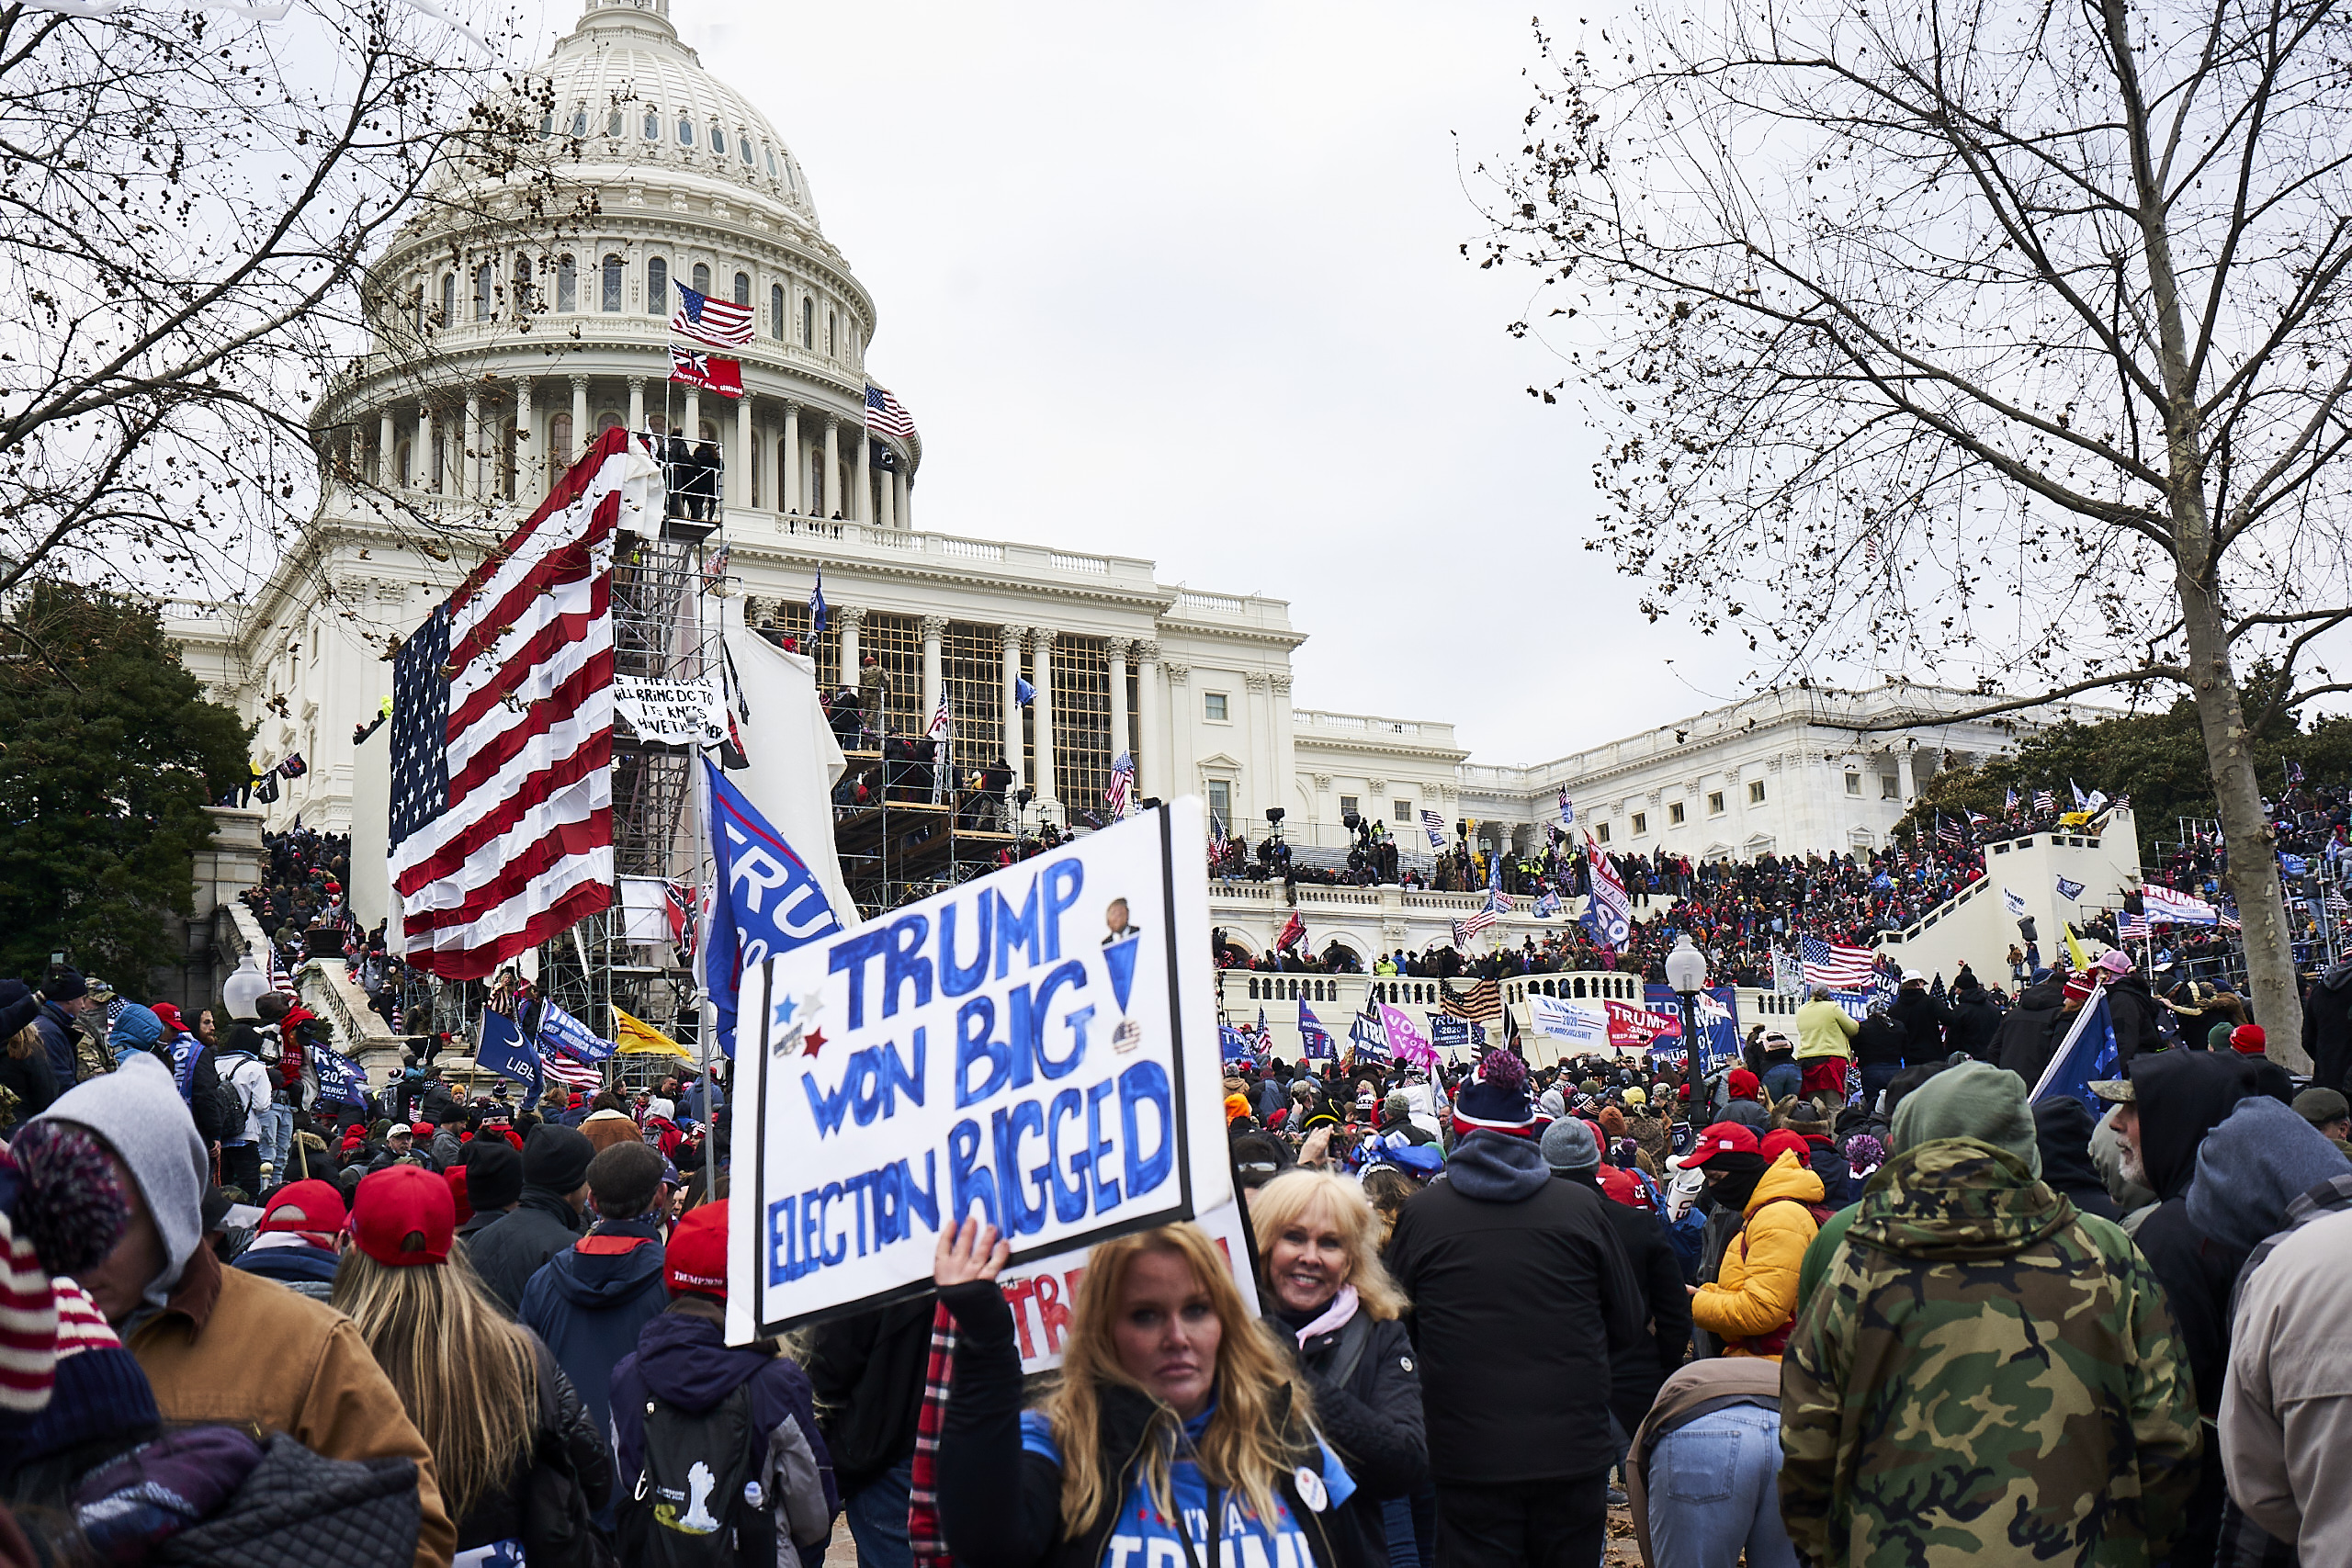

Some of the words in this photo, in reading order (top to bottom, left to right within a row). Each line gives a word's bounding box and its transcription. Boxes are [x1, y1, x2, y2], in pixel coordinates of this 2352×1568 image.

[636, 689, 674, 702] BRING
[829, 857, 1085, 1032] TRUMP
[801, 1025, 927, 1140] WON
[955, 959, 1095, 1111] BIG
[768, 1148, 940, 1288] ELECTION
[947, 1059, 1172, 1240] RIGGED
